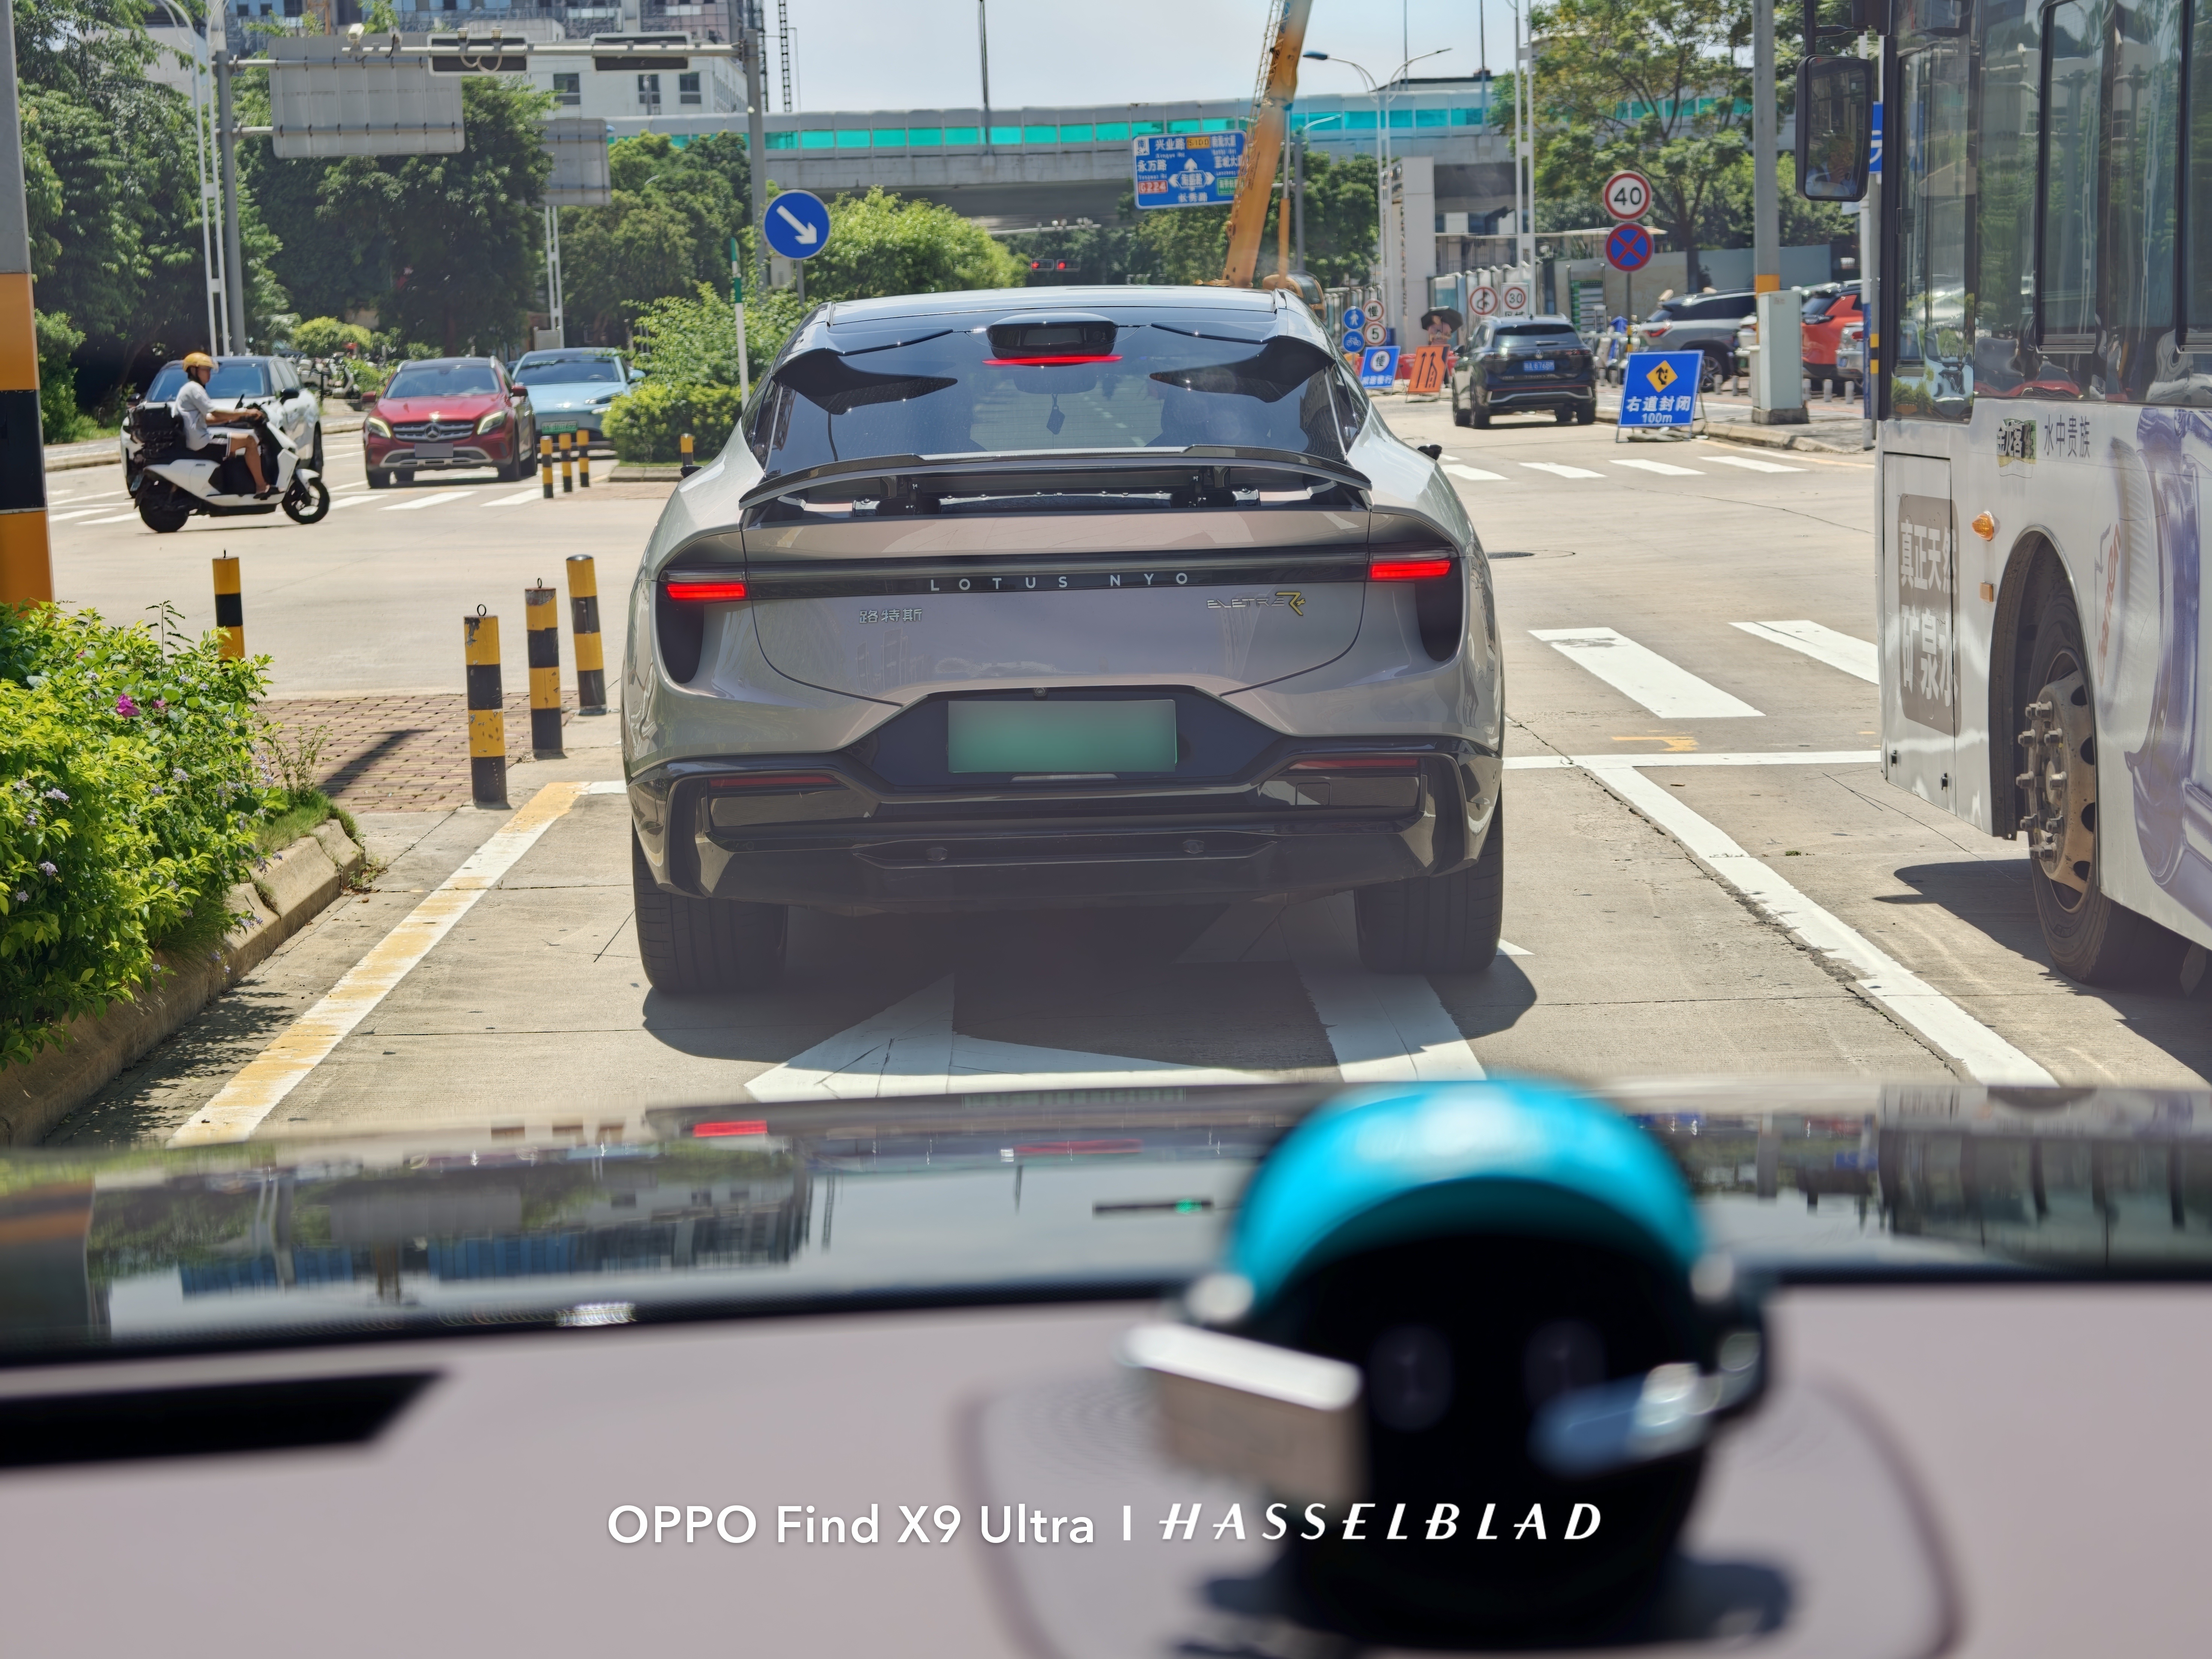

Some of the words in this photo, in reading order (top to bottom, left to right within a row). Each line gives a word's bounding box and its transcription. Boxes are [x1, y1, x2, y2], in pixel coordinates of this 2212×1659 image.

[1155, 138, 1185, 151] 兴业路
[1137, 159, 1167, 172] 永万路
[1141, 181, 1166, 192] G224
[1614, 187, 1642, 206] 40
[1509, 293, 1523, 303] 30
[1368, 305, 1378, 317] 慢
[1372, 328, 1379, 340] 5
[1626, 396, 1691, 412] 右道封闭
[1642, 413, 1672, 423] 100m
[2044, 414, 2090, 458] 水中贵族
[1901, 519, 1957, 596] 真正天然
[931, 576, 1068, 591] LOTUS
[1110, 573, 1188, 586] NYO
[859, 608, 922, 624] 路特斯
[1901, 604, 1958, 707] 矿泉水
